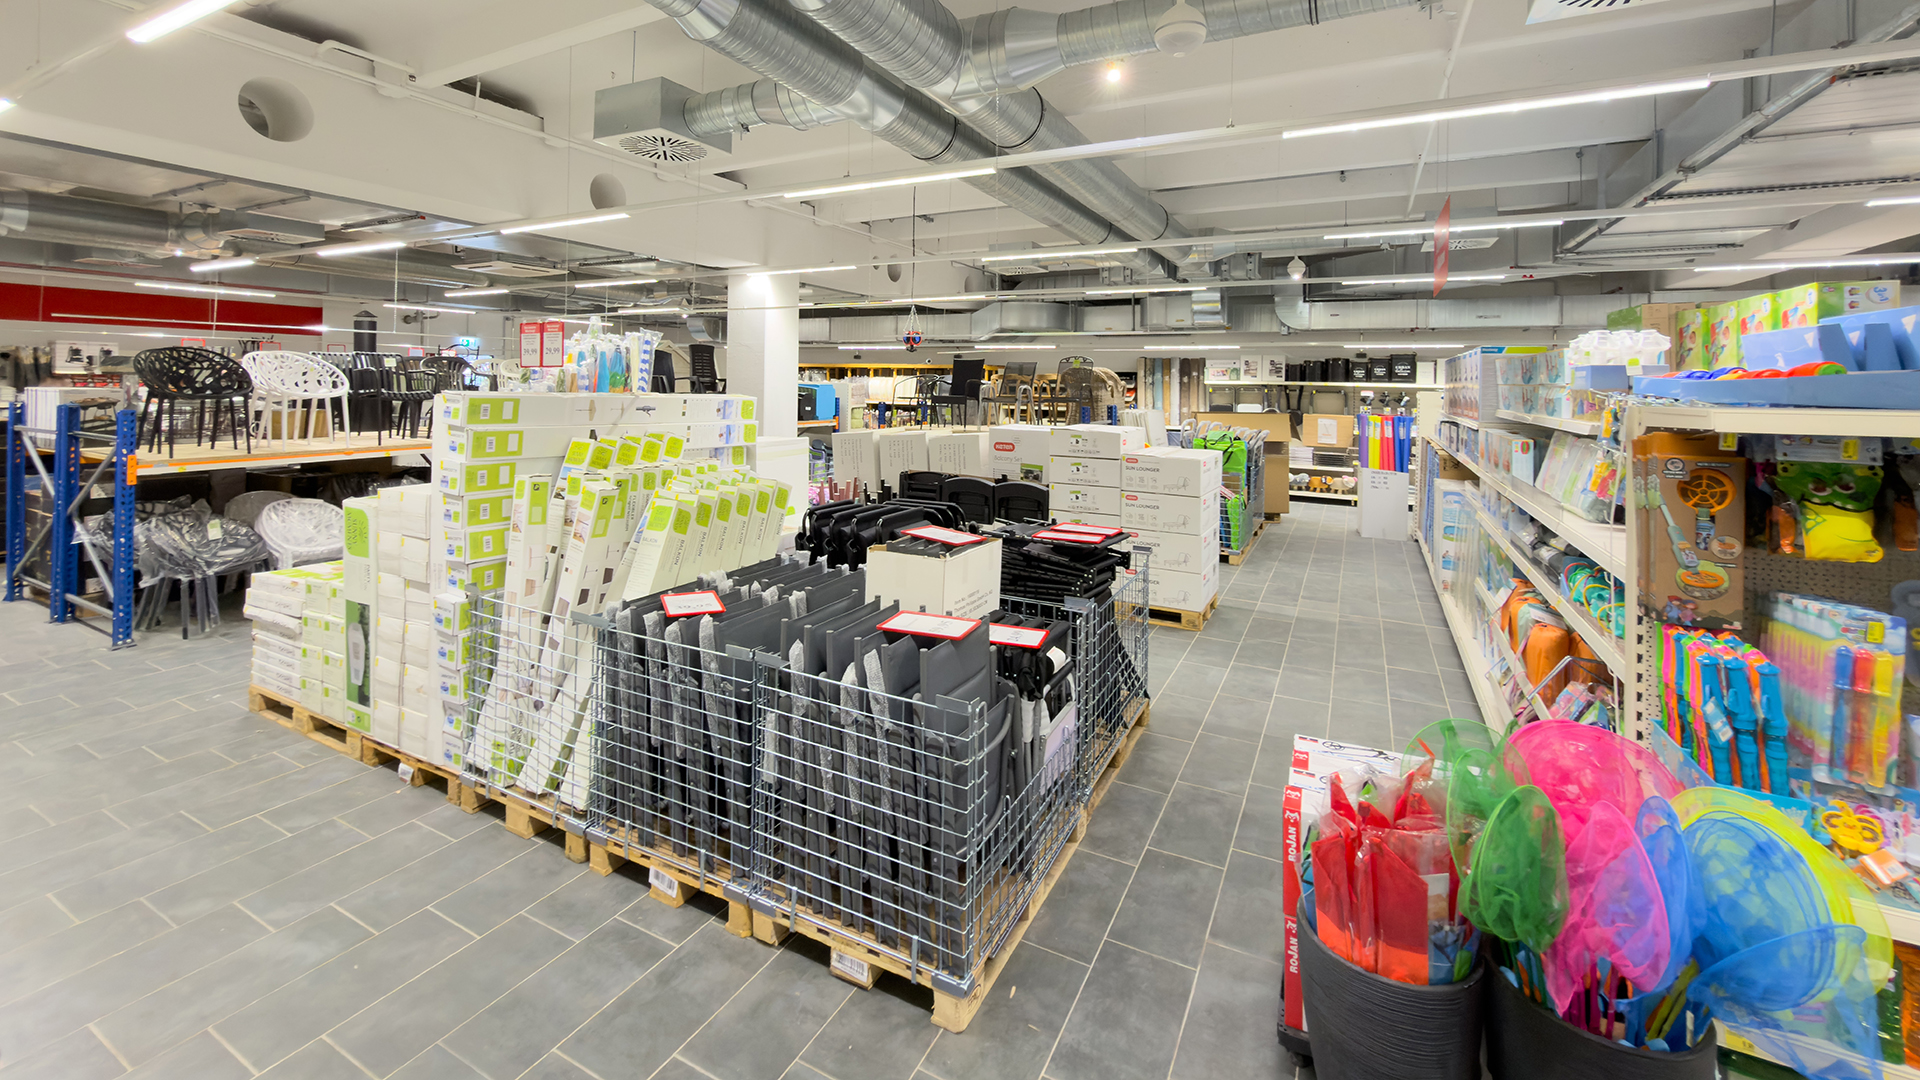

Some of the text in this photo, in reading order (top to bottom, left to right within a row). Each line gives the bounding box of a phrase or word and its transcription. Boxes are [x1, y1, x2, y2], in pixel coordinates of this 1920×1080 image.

[994, 454, 1013, 462] Balcony
[718, 526, 728, 551] BALKON
[738, 520, 746, 544] BALKON
[757, 517, 765, 540] BALKON
[674, 539, 685, 566] BALKON
[698, 531, 707, 557] BALKON
[1288, 825, 1298, 862] ROJAN
[1290, 935, 1299, 974] ROJAN
